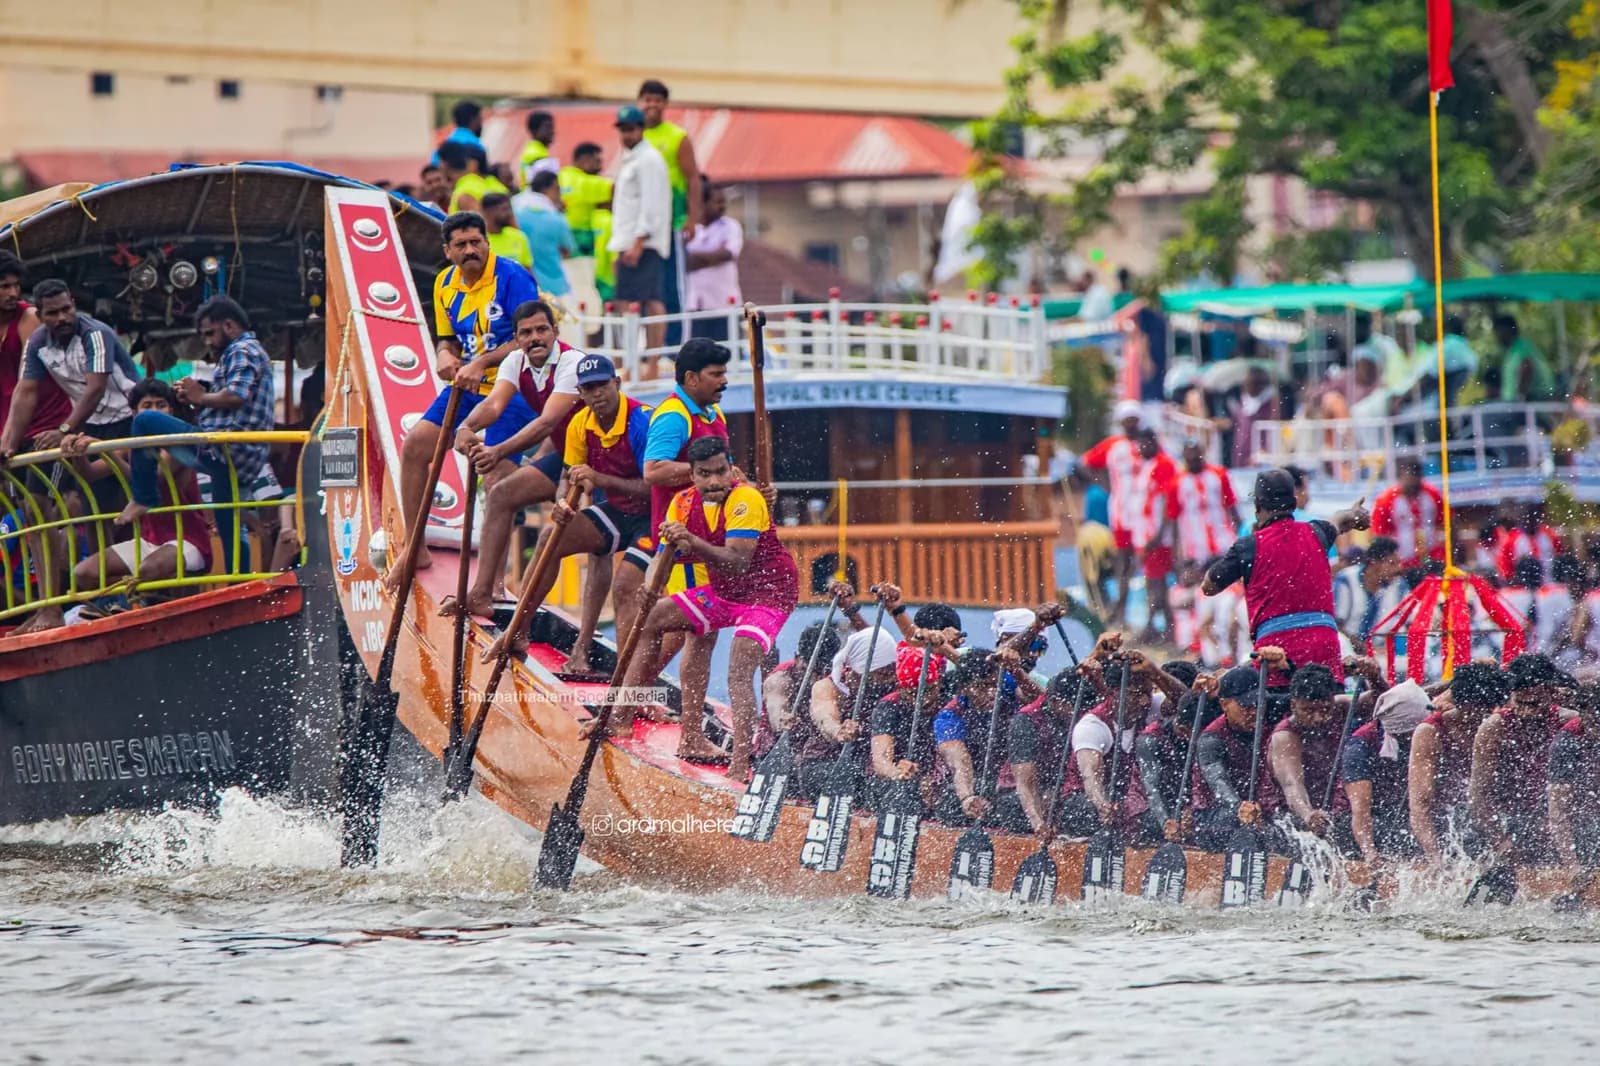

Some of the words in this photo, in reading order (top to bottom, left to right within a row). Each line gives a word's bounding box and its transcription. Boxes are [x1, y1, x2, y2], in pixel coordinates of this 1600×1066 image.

[578, 359, 599, 374] BOY
[820, 385, 878, 402] RIVER
[886, 387, 960, 404] CRUISE
[350, 579, 382, 612] NCDC
